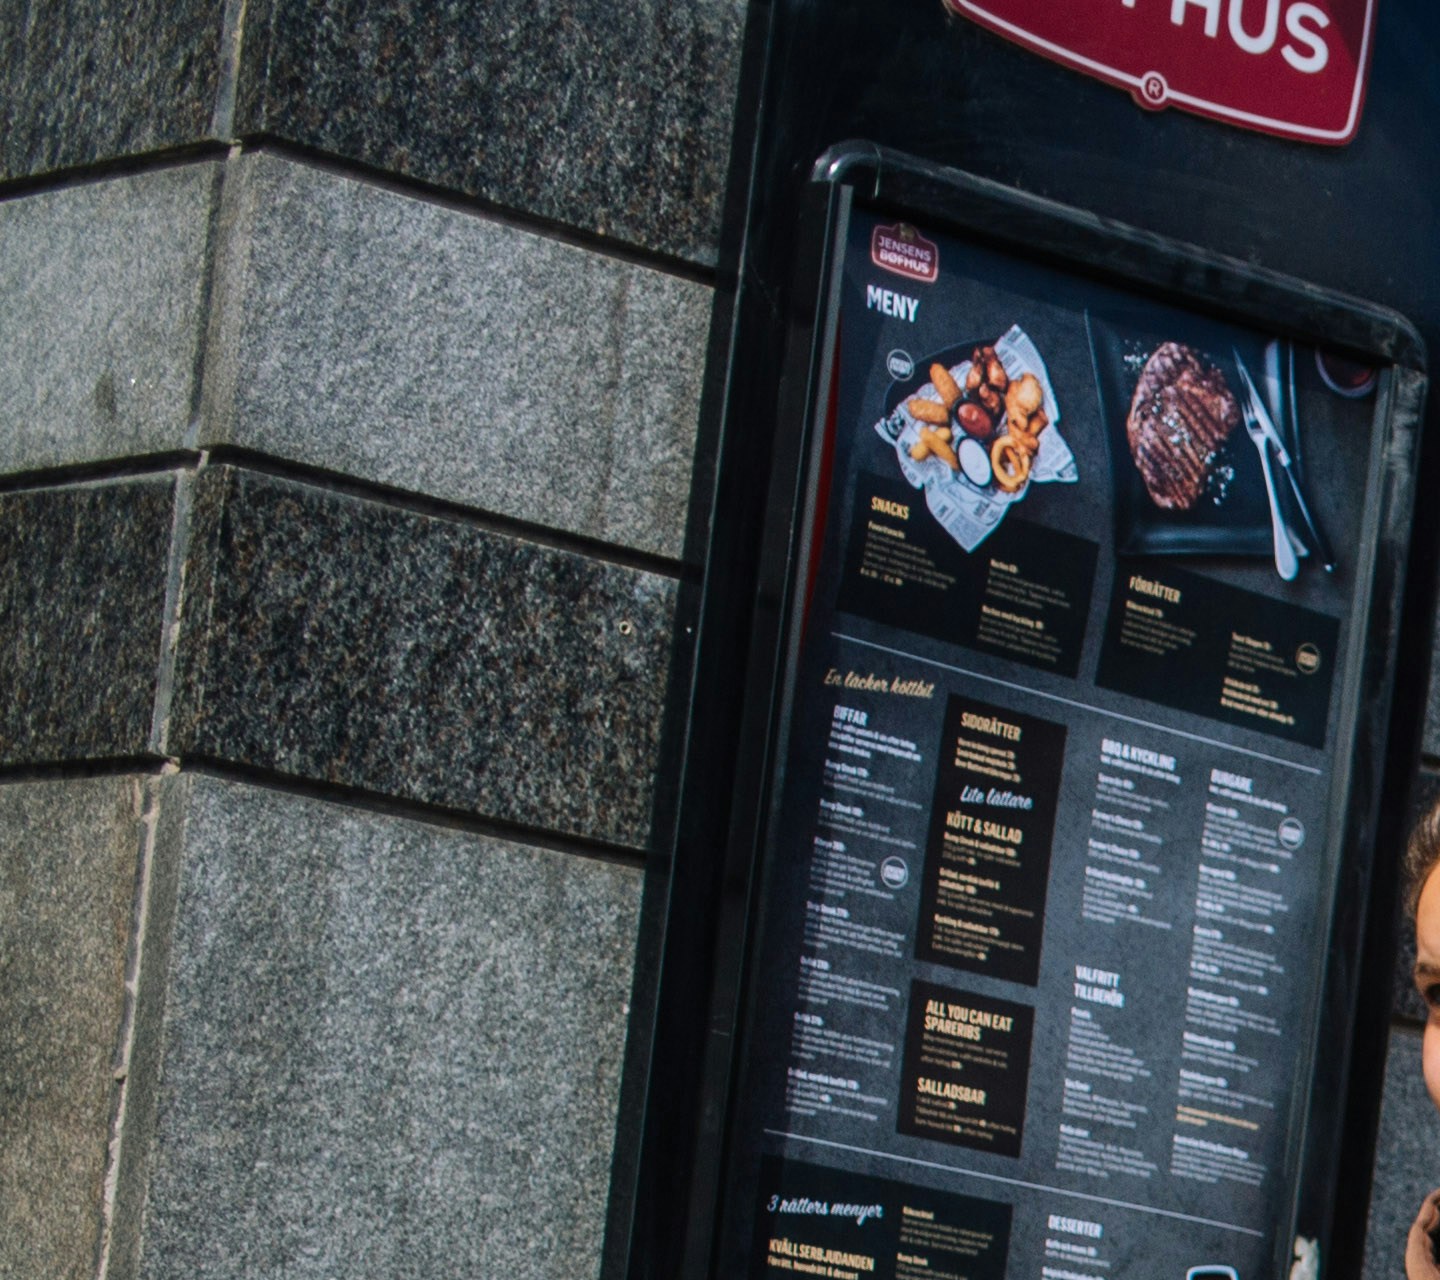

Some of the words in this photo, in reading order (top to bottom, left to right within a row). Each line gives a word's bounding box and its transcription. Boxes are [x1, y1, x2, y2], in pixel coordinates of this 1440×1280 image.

[1121, 0, 1331, 73] HUS
[878, 235, 932, 262] JENSENS
[867, 284, 919, 322] MENY
[871, 496, 910, 520] SNACKS
[946, 810, 974, 834] KÖTT
[973, 820, 983, 835] &
[983, 821, 1023, 845] SALLAD
[924, 1015, 982, 1042] SPARERIBS
[925, 999, 946, 1018] ALL
[948, 1004, 970, 1024] YOU
[969, 1008, 992, 1028] CAN
[992, 1014, 1014, 1033] EAT
[917, 1077, 987, 1106] SALLADSBAR
[766, 1194, 780, 1213] 3
[830, 1202, 884, 1227] menyer
[1048, 1214, 1103, 1239] DESSERTER
